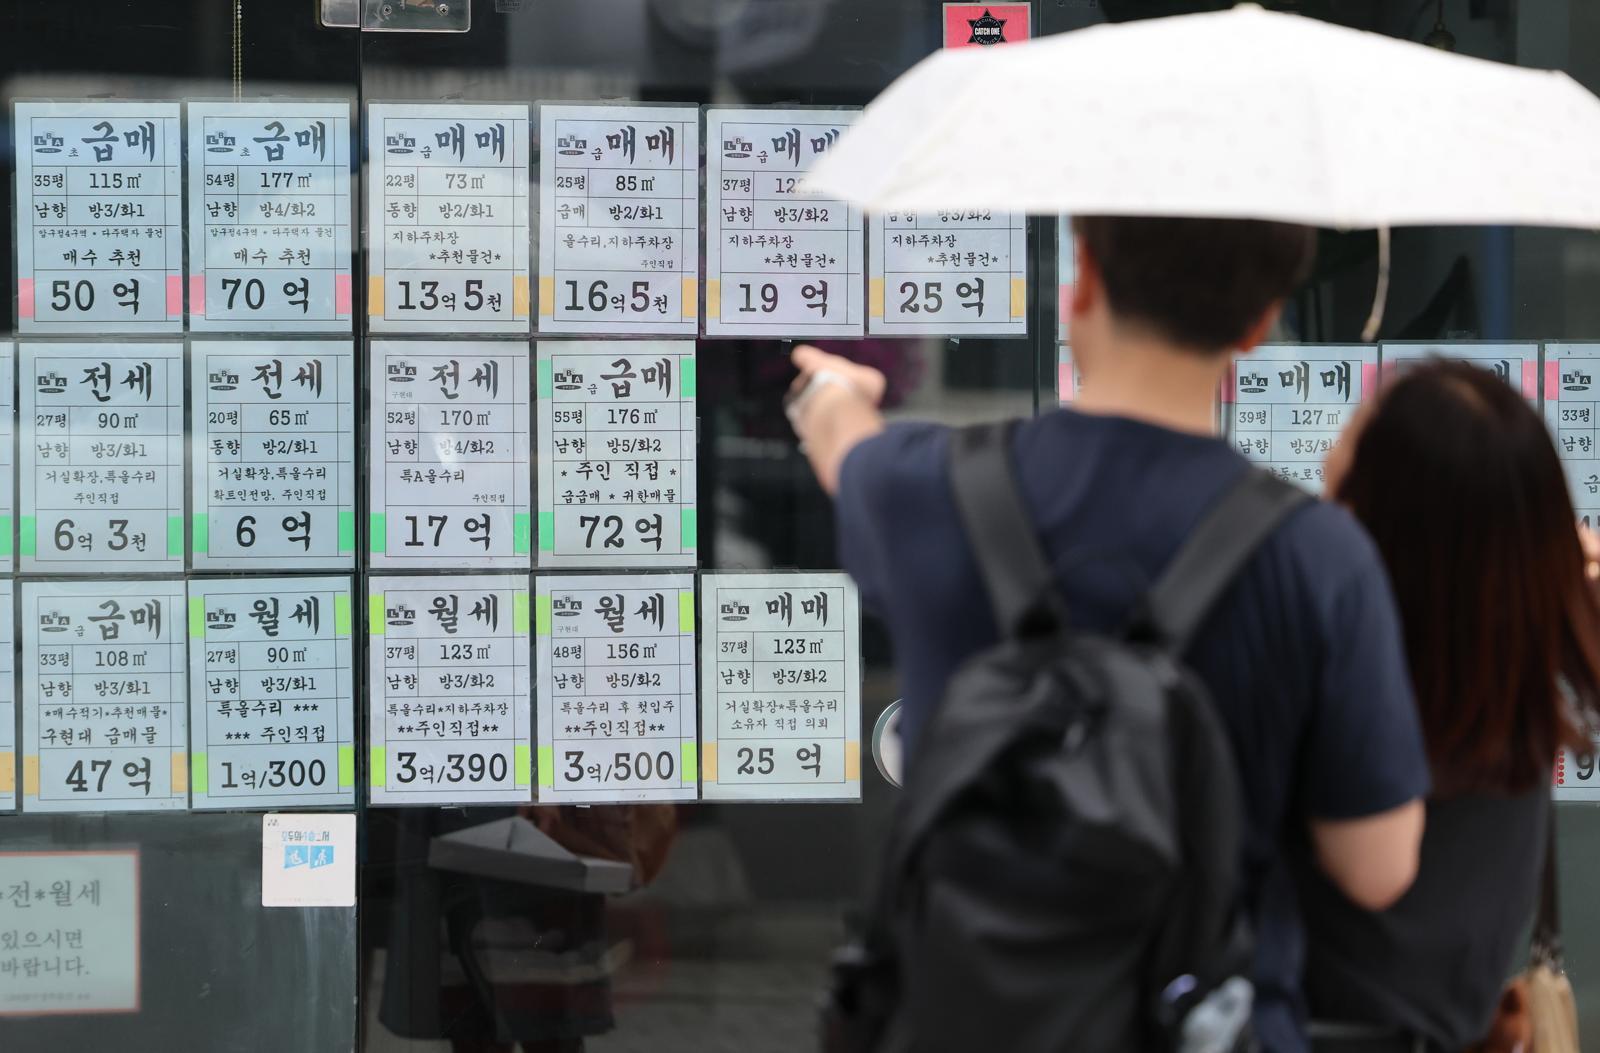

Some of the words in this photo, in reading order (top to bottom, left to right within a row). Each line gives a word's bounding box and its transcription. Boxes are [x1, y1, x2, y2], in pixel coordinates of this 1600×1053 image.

[974, 27, 991, 36] CATCH
[990, 27, 1000, 36] ONE
[81, 121, 155, 163] 급매
[252, 121, 325, 162] 급매
[435, 123, 505, 164] 매매
[605, 125, 674, 165] 매매
[34, 174, 63, 188] 35평
[206, 174, 236, 187] 54평
[386, 174, 416, 188] 22평
[557, 175, 585, 190] 25평
[723, 178, 751, 192] 37평
[35, 202, 65, 218] 남향
[88, 202, 145, 218] 방3/화1
[206, 202, 236, 218] 남향
[259, 200, 315, 218] 방4/화2
[386, 200, 416, 218] 동향
[438, 202, 494, 219] 방2/화1
[557, 204, 585, 220] 급매
[609, 205, 664, 221] 방2/화1
[723, 206, 752, 222] 남향
[774, 207, 829, 224] 방3/화2
[393, 231, 459, 245] 지하주차장
[728, 235, 794, 248] 지하주차장
[891, 234, 957, 247] 지하주차장
[62, 248, 99, 267] 매수
[108, 248, 140, 267] 추천
[234, 248, 268, 266] 매수
[278, 248, 310, 266] 추천
[79, 362, 152, 402] 전세
[251, 359, 322, 400] 전세
[428, 360, 498, 400] 전세
[599, 358, 671, 400] 급매
[1278, 362, 1351, 402] 매매
[37, 414, 67, 429] 27평
[209, 412, 238, 425] 20평
[387, 412, 416, 426] 52평
[555, 411, 584, 424] 55평
[1239, 410, 1267, 424] 39평
[1562, 408, 1590, 422] 33평
[37, 443, 69, 459] 남향
[91, 442, 147, 459] 방3/화1
[210, 440, 239, 456] 동향
[262, 439, 318, 456] 방2/화1
[387, 439, 417, 456] 남향
[440, 439, 496, 456] 방4/화2
[555, 439, 584, 454] 남향
[607, 439, 663, 454] 방5/화2
[1239, 438, 1269, 454] 남향
[1562, 436, 1592, 453] 남향
[400, 468, 464, 484] 특A올수리
[576, 463, 613, 482] 주인
[624, 462, 661, 482] 직접
[74, 492, 118, 504] 주인직접
[281, 488, 326, 502] 주인직접
[561, 490, 600, 503] 급급매
[248, 596, 319, 638] 월세
[427, 594, 498, 634] 월세
[594, 593, 664, 633] 월세
[765, 591, 828, 628] 매매
[87, 599, 161, 641] 급매
[387, 647, 416, 661] 37평
[554, 646, 582, 661] 48평
[721, 640, 748, 655] 37평
[40, 652, 69, 667] 33평
[207, 650, 236, 664] 27평
[387, 674, 416, 691] 남향
[438, 674, 495, 690] 방3/화2
[554, 674, 583, 689] 남향
[606, 672, 661, 689] 방5/화2
[720, 668, 751, 685] 남향
[772, 668, 828, 685] 방3/화2
[41, 681, 71, 697] 남향
[94, 680, 151, 697] 방3/화1
[208, 677, 238, 695] 남향
[259, 677, 317, 693] 방3/화1
[217, 700, 282, 718] 특올수리
[560, 701, 609, 715] 특올수리
[616, 701, 631, 715] 후
[635, 699, 675, 714] 첫입주
[731, 718, 768, 731] 소유자
[774, 717, 796, 731] 직접
[805, 717, 828, 730] 의뢰
[41, 728, 91, 746] 구현대
[260, 725, 325, 742] 주인직접
[396, 752, 507, 784] 3억/390
[564, 751, 674, 783] 3억/500
[1, 956, 91, 978] 바랍니다.
